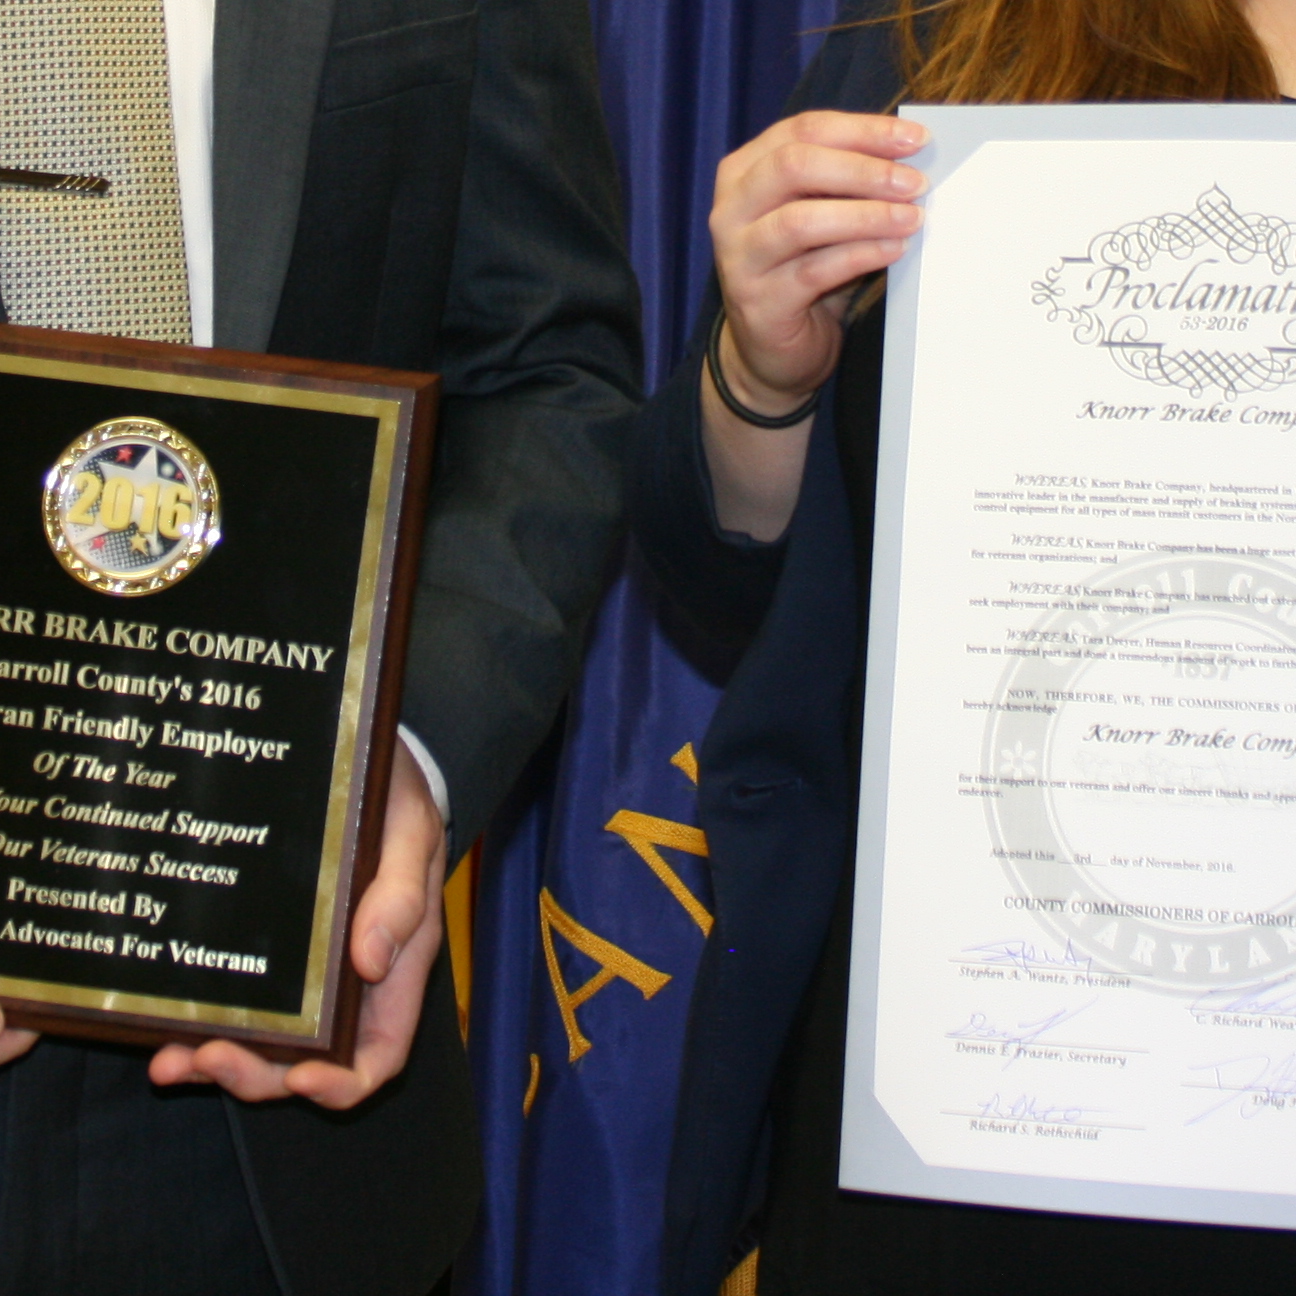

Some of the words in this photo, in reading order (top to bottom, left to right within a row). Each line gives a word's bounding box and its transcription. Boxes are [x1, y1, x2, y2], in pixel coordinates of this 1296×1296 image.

[1179, 314, 1249, 332] 53-2016
[1077, 396, 1155, 420] Knorr
[1160, 399, 1232, 423] Brake
[66, 470, 194, 540] 2016
[42, 612, 157, 650] BRAKE
[165, 628, 333, 671] COMPANY
[77, 664, 193, 703] County's
[198, 679, 262, 710] 2016
[1008, 688, 1037, 699] NOW,
[1044, 690, 1117, 704] THEREFORE,
[1122, 694, 1144, 705] WE,
[1150, 696, 1172, 707] THE
[1177, 697, 1280, 713] COMMISSIONERS
[42, 706, 154, 749] Friendly
[162, 722, 290, 762] Employer
[1083, 722, 1160, 745] Knorr
[1164, 725, 1234, 749] Brake
[32, 750, 69, 779] Of
[72, 755, 116, 783] The
[124, 762, 176, 789] Year
[44, 794, 170, 832] Continued
[170, 810, 269, 845] Support
[40, 838, 140, 873] Veterans
[143, 851, 238, 885] Success
[6, 878, 125, 915] Presented
[132, 894, 167, 924] By
[1004, 895, 1066, 911] COUNTY
[1071, 899, 1203, 919] COMMISSIONERS
[1207, 907, 1231, 921] OF
[120, 933, 161, 960] For
[168, 940, 266, 975] Veterans
